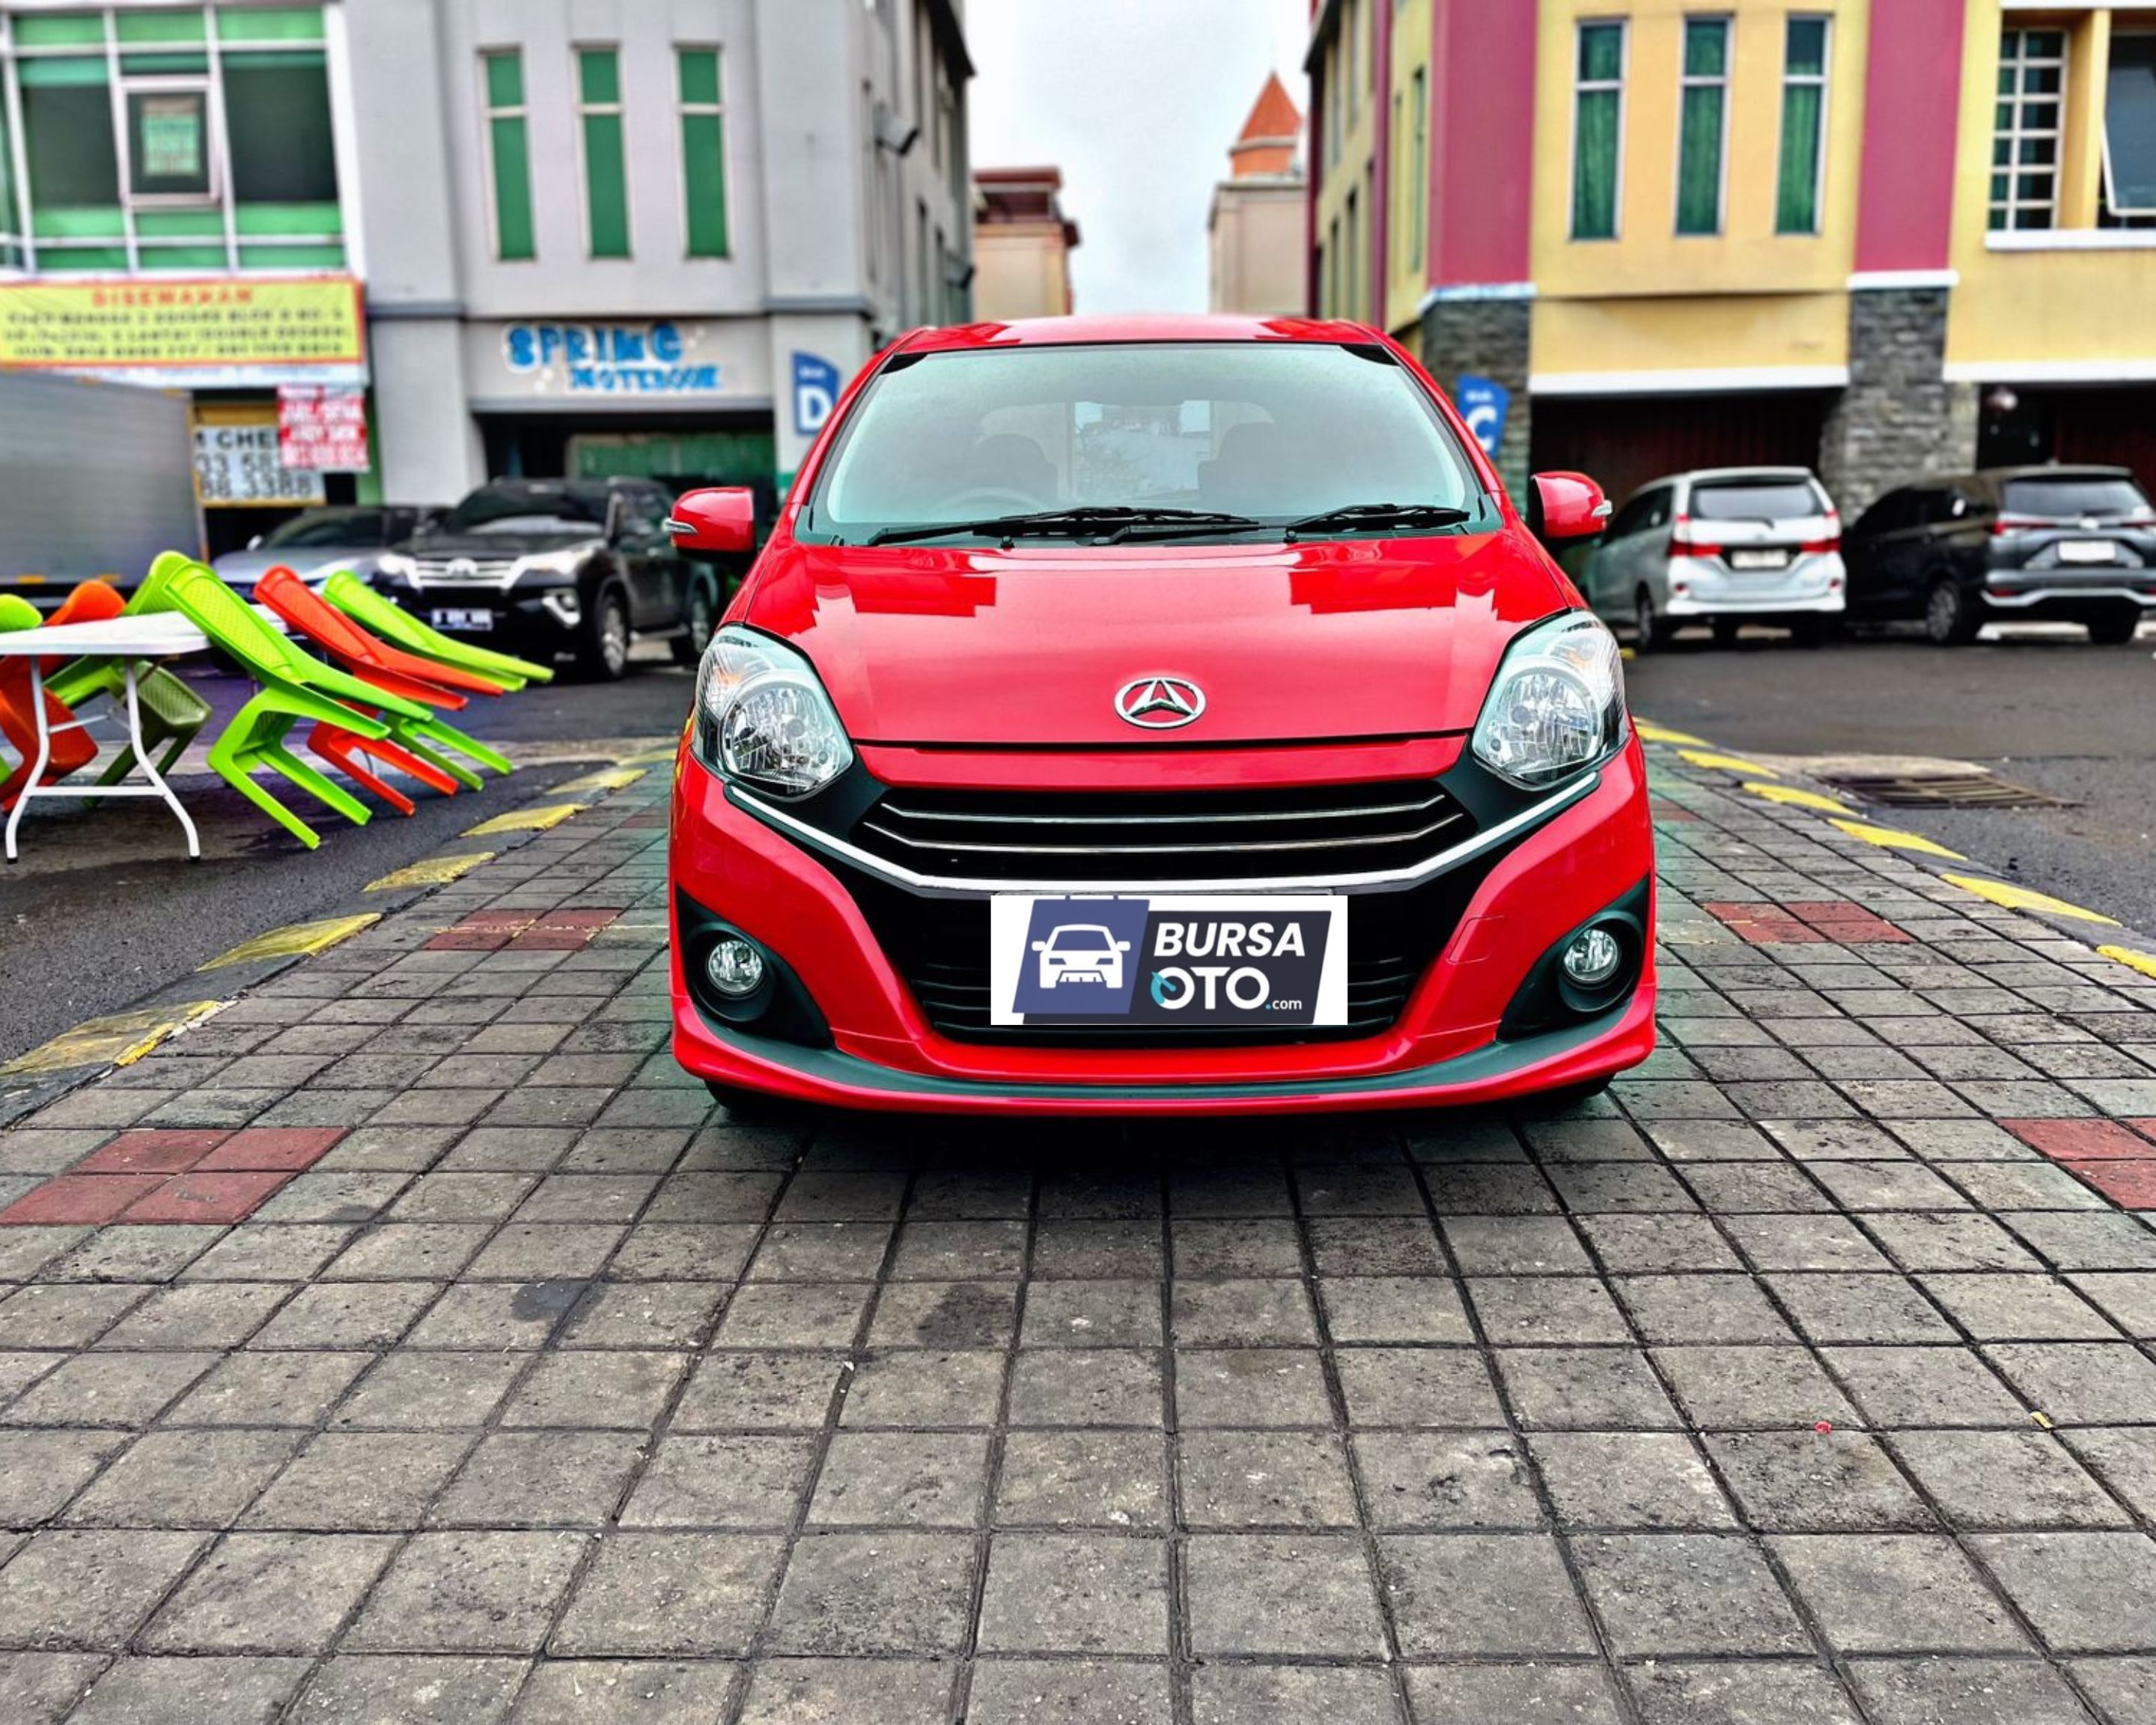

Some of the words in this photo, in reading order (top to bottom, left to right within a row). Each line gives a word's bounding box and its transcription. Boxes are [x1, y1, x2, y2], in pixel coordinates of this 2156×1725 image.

[508, 320, 683, 368] SPRING
[570, 365, 718, 391] NOTEBOOK
[799, 386, 834, 430] D
[1465, 405, 1498, 452] C
